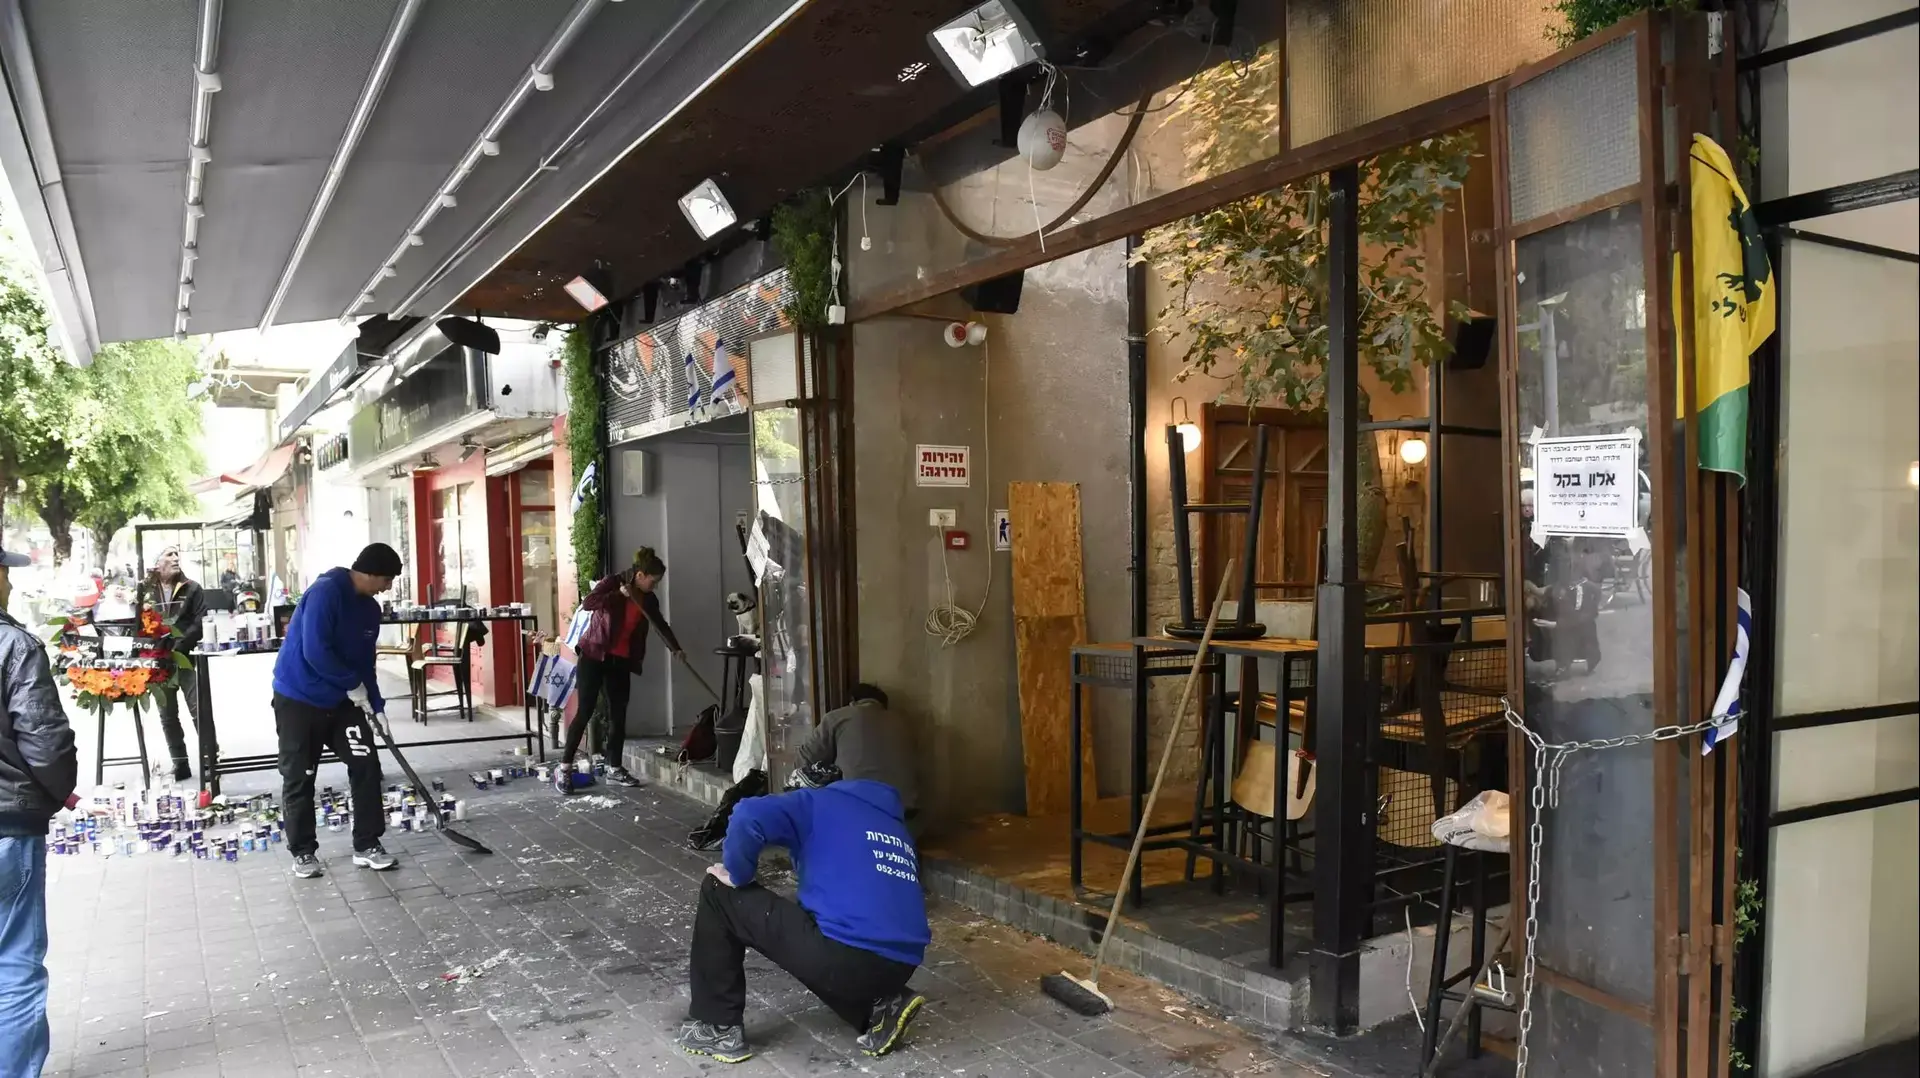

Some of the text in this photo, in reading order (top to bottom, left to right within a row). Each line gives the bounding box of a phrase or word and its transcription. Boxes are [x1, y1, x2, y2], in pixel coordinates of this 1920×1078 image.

[922, 451, 964, 463] זהירות
[920, 465, 966, 478] מדרגה!
[1553, 472, 1615, 488] אלון בקל
[865, 831, 902, 848] הדברות
[876, 863, 919, 884] 052-2510
